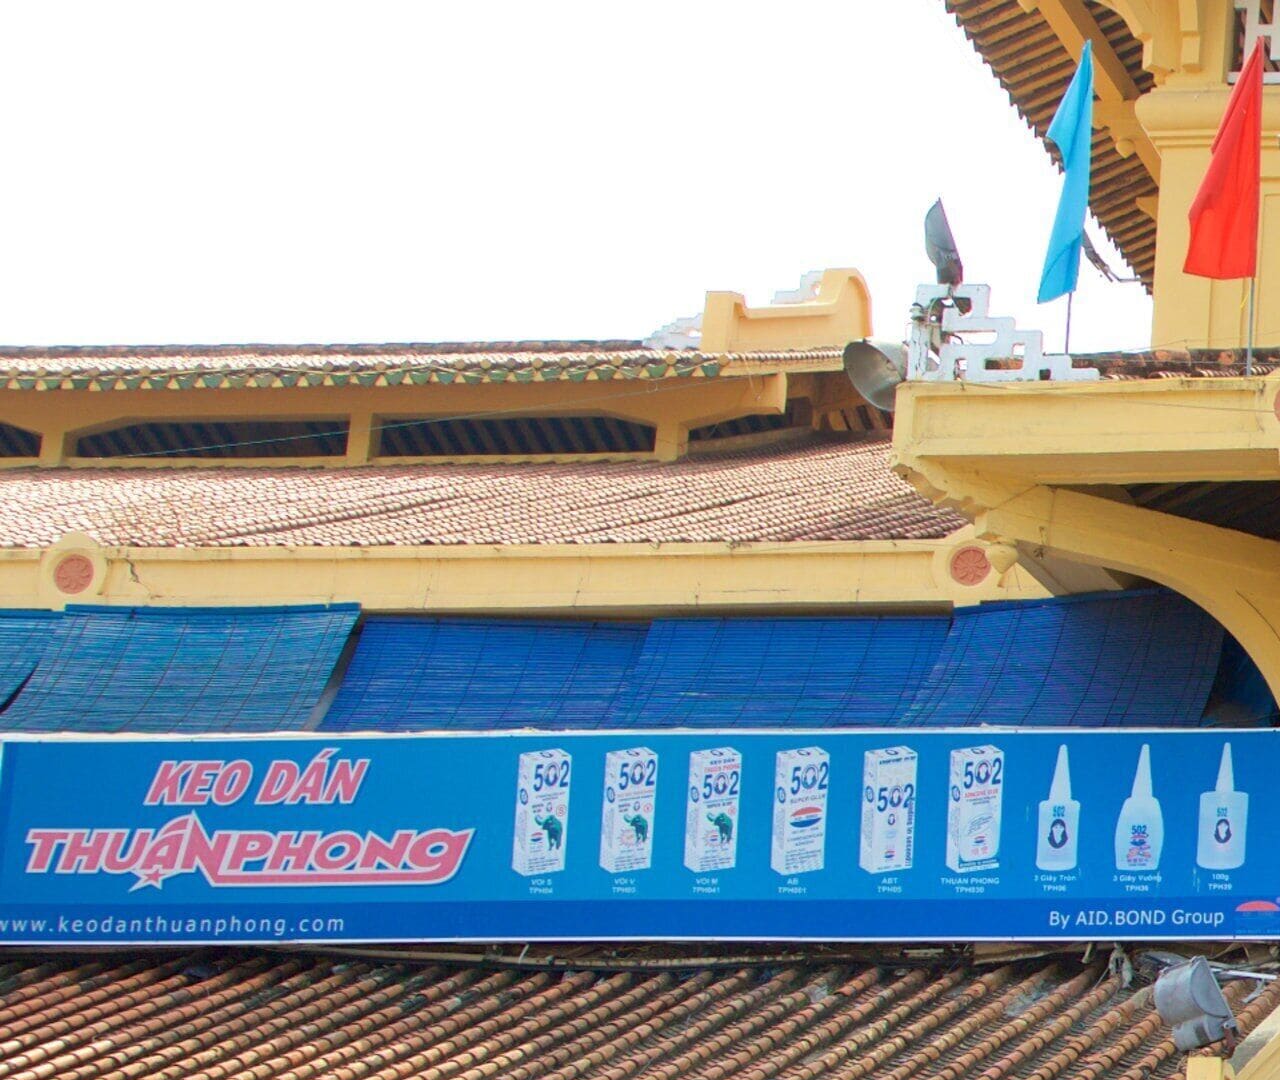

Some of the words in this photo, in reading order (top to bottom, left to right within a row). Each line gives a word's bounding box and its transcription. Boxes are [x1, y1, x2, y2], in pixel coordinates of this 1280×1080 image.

[144, 759, 253, 806] KEO
[255, 748, 371, 804] DÁN
[1049, 911, 1071, 929] By
[1075, 911, 1166, 926] AID.BOND
[1171, 909, 1224, 928] Group
